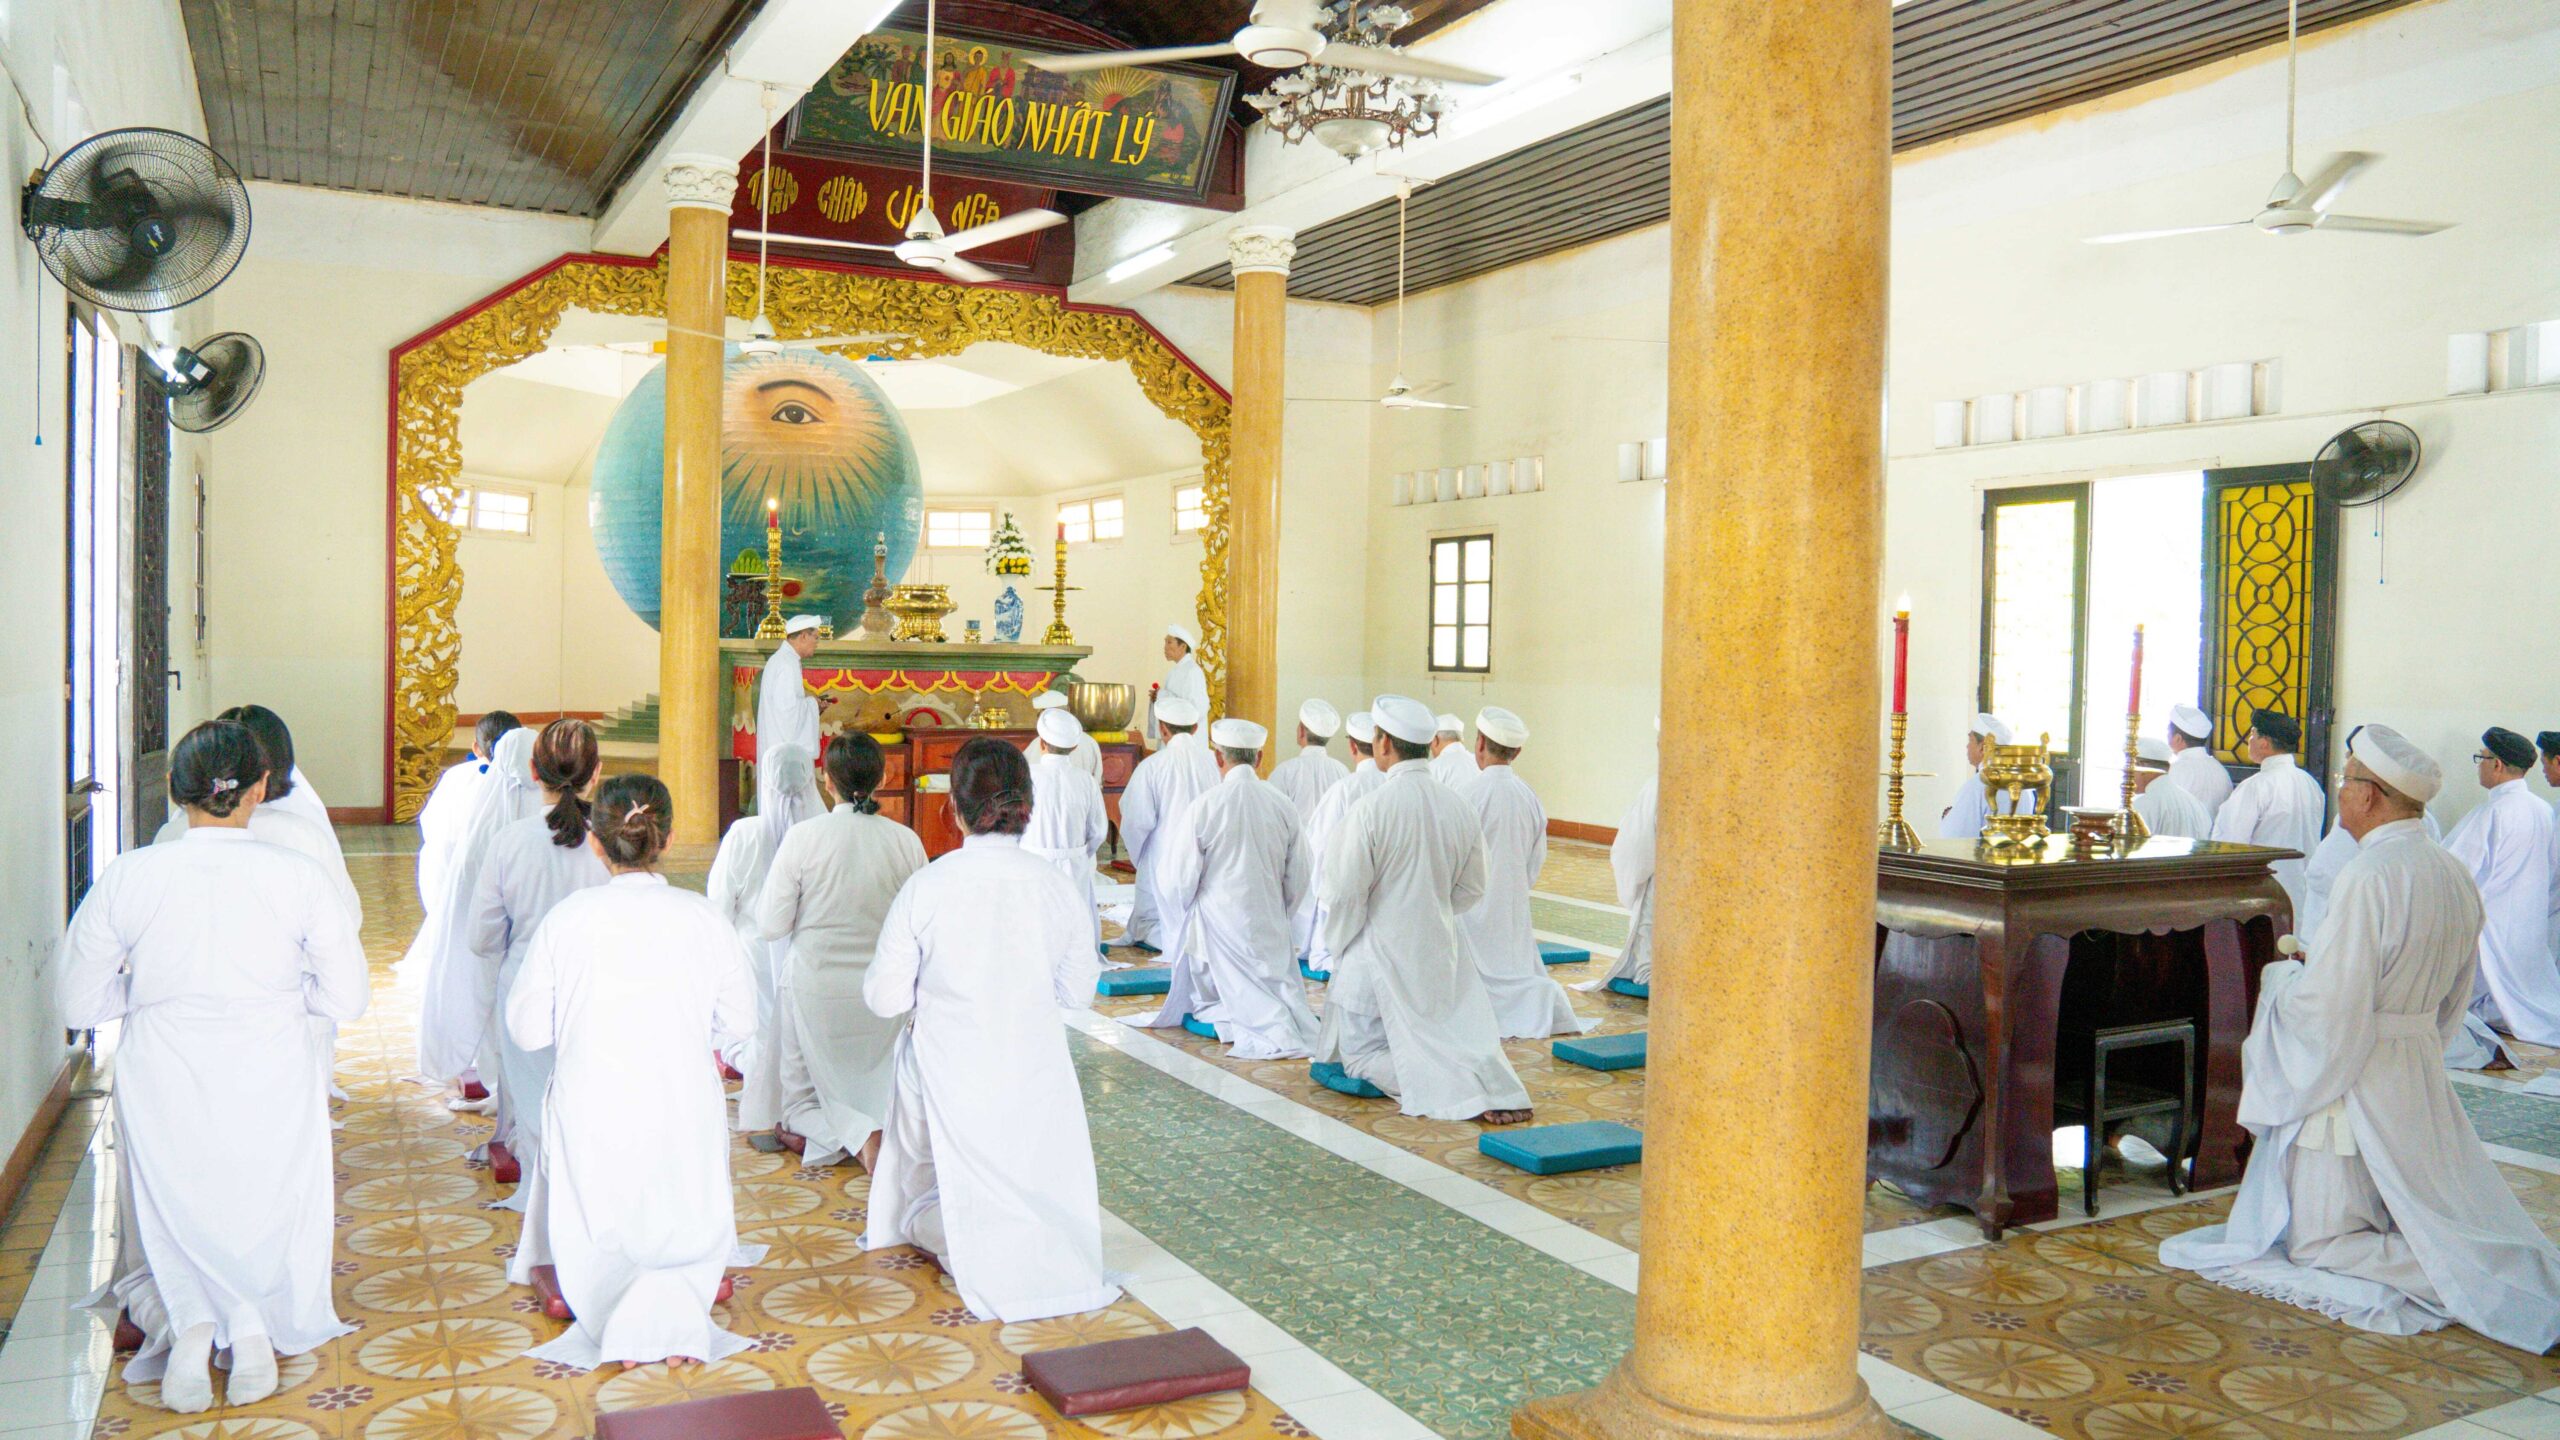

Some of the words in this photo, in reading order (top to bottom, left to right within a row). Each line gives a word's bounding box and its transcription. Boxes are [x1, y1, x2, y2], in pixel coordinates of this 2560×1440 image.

[869, 78, 927, 138] VẠN
[941, 87, 1016, 147] GIÁO
[1016, 100, 1113, 160] NHẤT
[1110, 111, 1156, 166] LÝ
